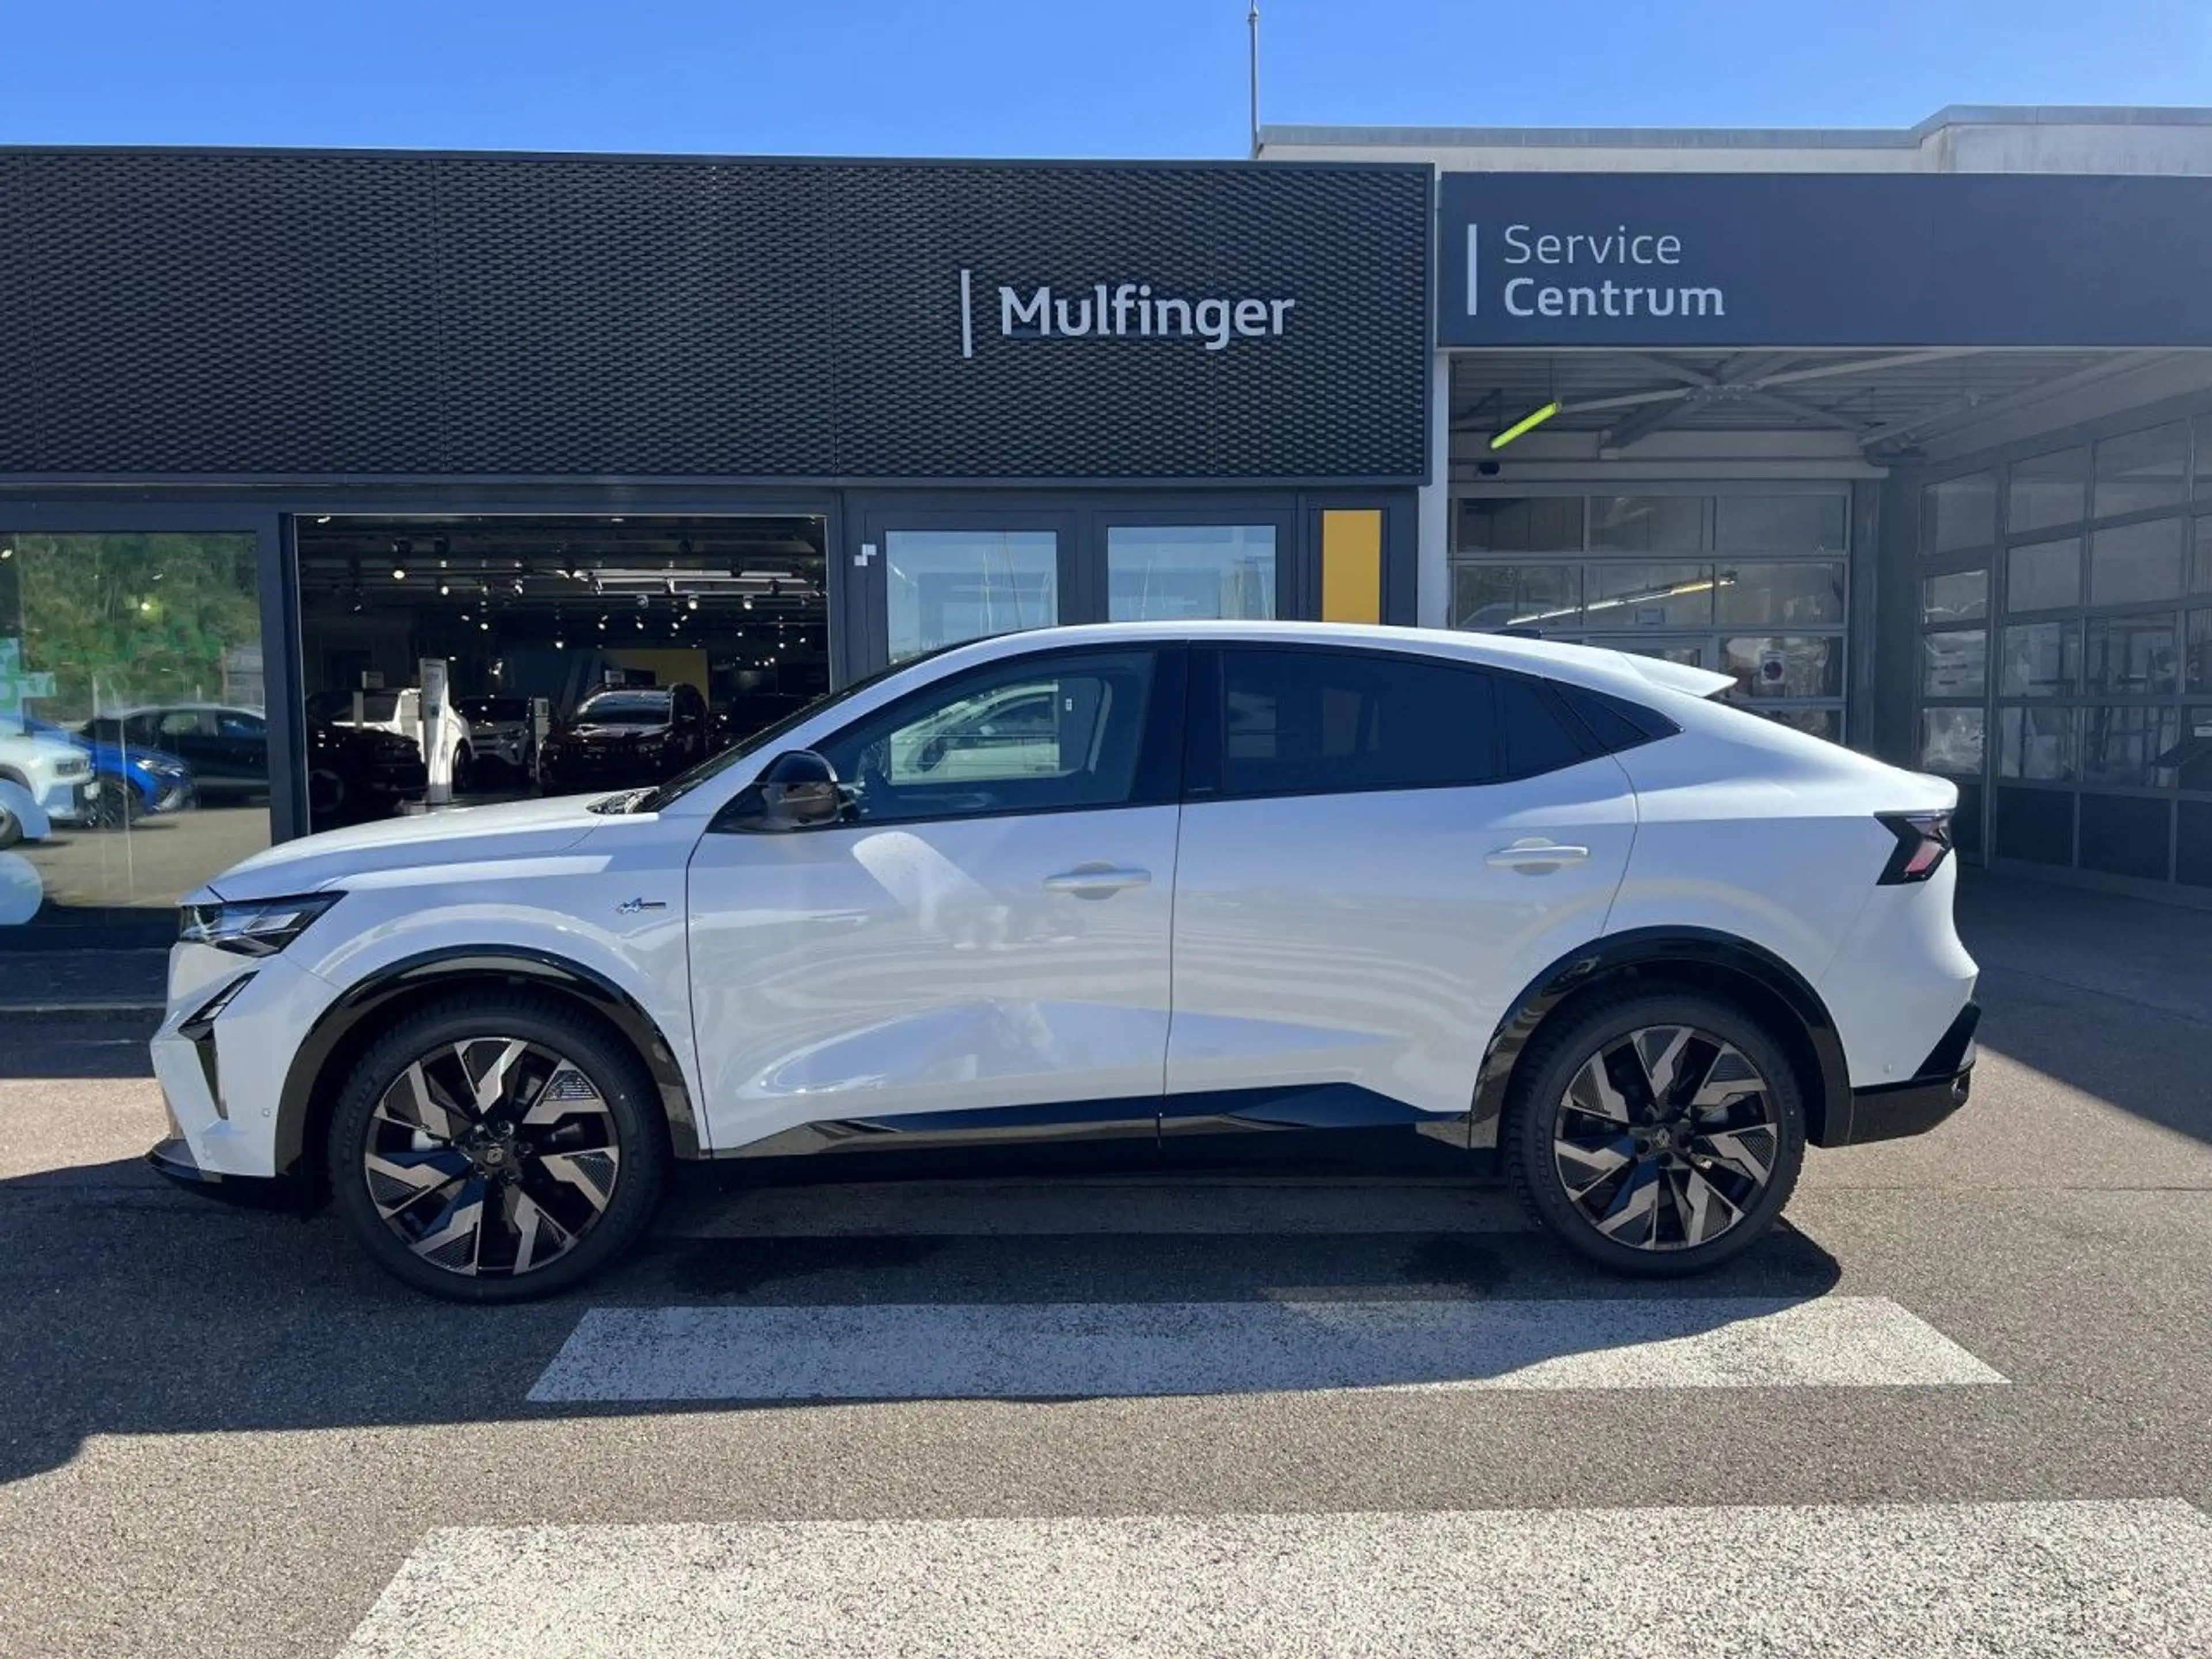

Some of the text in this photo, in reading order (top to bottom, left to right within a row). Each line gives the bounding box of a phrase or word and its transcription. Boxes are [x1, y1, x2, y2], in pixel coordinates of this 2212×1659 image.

[1504, 225, 1681, 264] Service
[1504, 278, 1725, 316] Centrum
[998, 284, 1296, 350] Mulfinger
